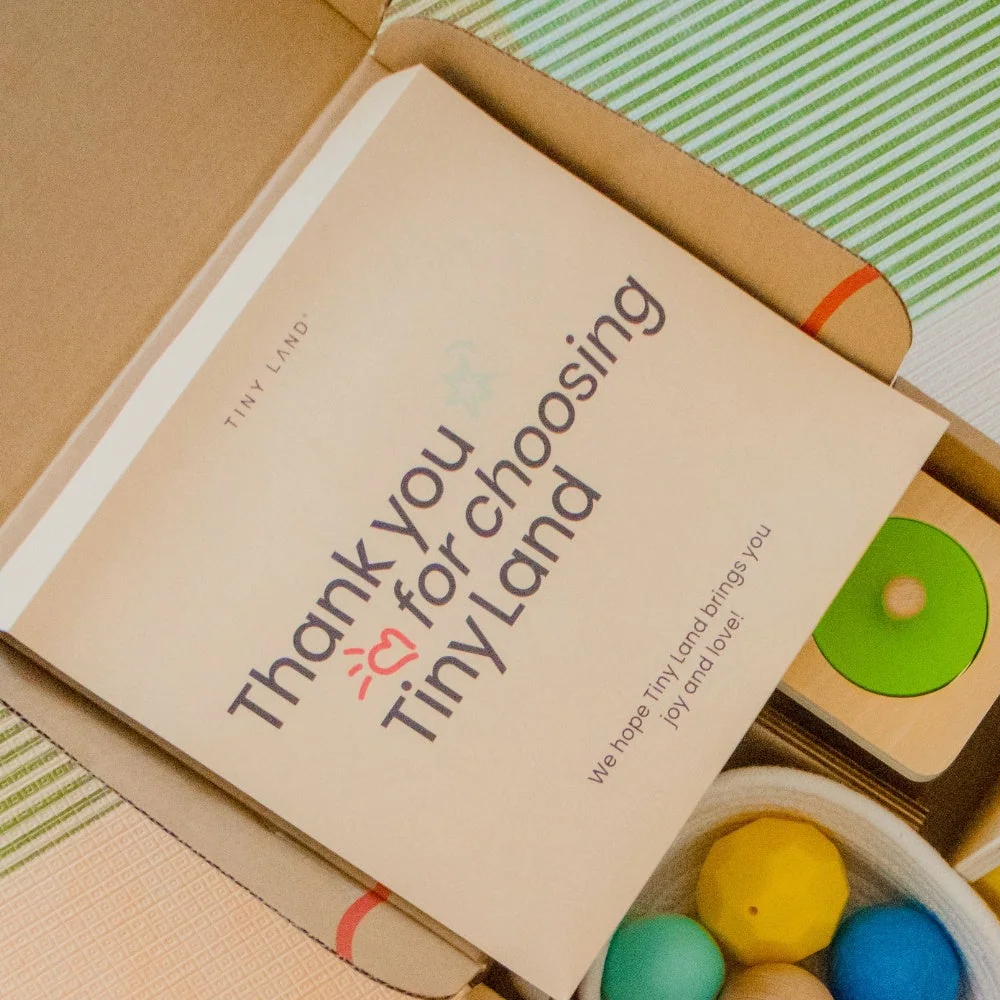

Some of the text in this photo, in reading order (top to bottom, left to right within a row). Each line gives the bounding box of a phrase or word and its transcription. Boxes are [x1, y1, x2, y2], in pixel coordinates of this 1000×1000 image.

[224, 379, 264, 428] TINY
[393, 274, 667, 629] for choosing
[227, 424, 475, 730] Thank you
[380, 464, 602, 743] Tiny Land
[588, 523, 772, 785] We hope Tiny Land brings you
[659, 609, 745, 731] joy and love!
